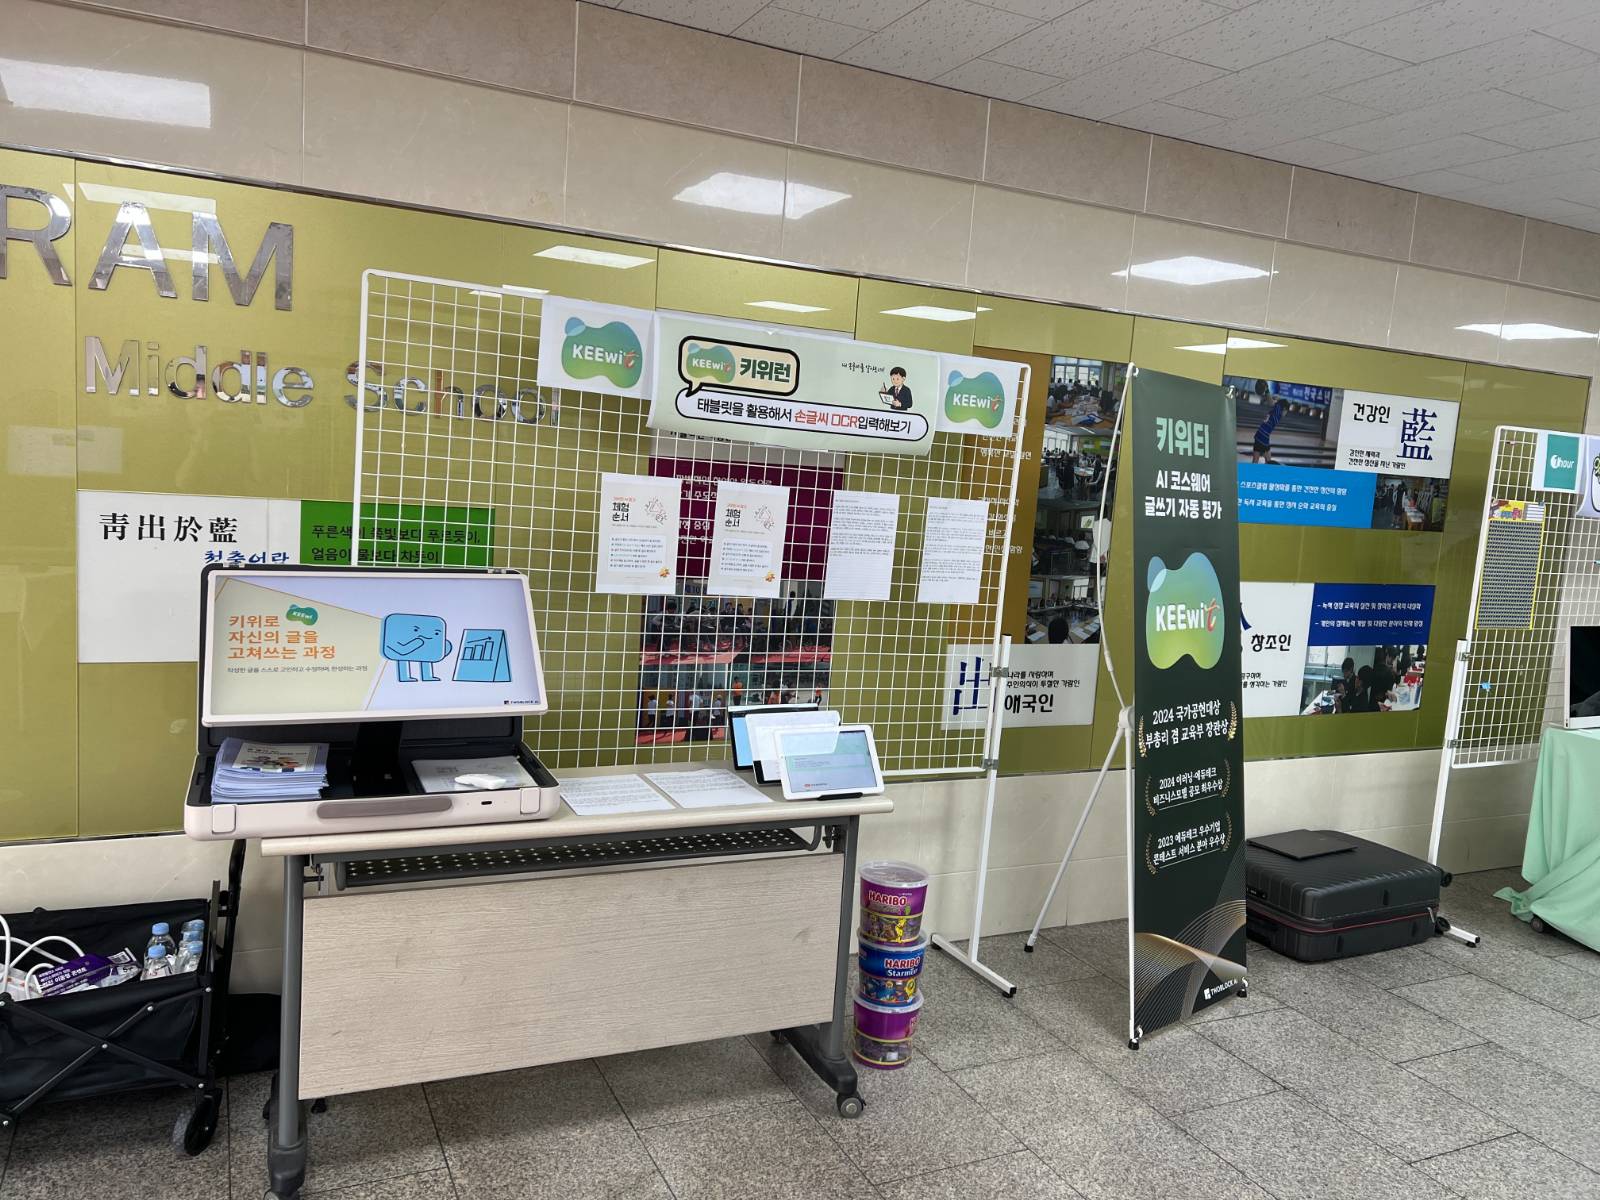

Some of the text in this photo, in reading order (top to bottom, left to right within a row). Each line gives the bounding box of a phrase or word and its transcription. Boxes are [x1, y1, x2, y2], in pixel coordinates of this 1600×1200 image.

[740, 358, 791, 383] 키위런
[85, 336, 559, 427] Middle School
[697, 398, 743, 417] 태블릿을
[746, 404, 792, 422] 활용해서
[794, 410, 829, 425] 손글씨
[1353, 403, 1391, 424] 건강인
[1156, 417, 1210, 459] 키위티
[1396, 408, 1438, 461] 藍
[1156, 469, 1210, 493] AI 코스웨어
[612, 502, 630, 513] 체험
[612, 512, 629, 522] 순서
[1145, 496, 1222, 519] 글쓰기 자동 평가
[229, 615, 280, 629] 키위로
[228, 630, 319, 644] 자신의 글을
[1251, 634, 1292, 652] 창조인
[227, 645, 336, 660] 고쳐쓰는 과정
[1004, 693, 1054, 714] 애국인
[1152, 699, 1221, 725] 2024 국가공헌대상
[1146, 718, 1229, 749] 부총리 겸 교육부 장관상
[1160, 776, 1175, 790] 2024
[1153, 786, 1188, 805] 비즈니스모델
[1188, 785, 1201, 798] 공모
[1158, 820, 1221, 849] 2023 에듀테크 우수기업
[1178, 843, 1196, 857] 서비스
[1209, 832, 1226, 847] 우수상
[868, 890, 907, 906] HARIBO
[884, 956, 921, 970] HARIBO
